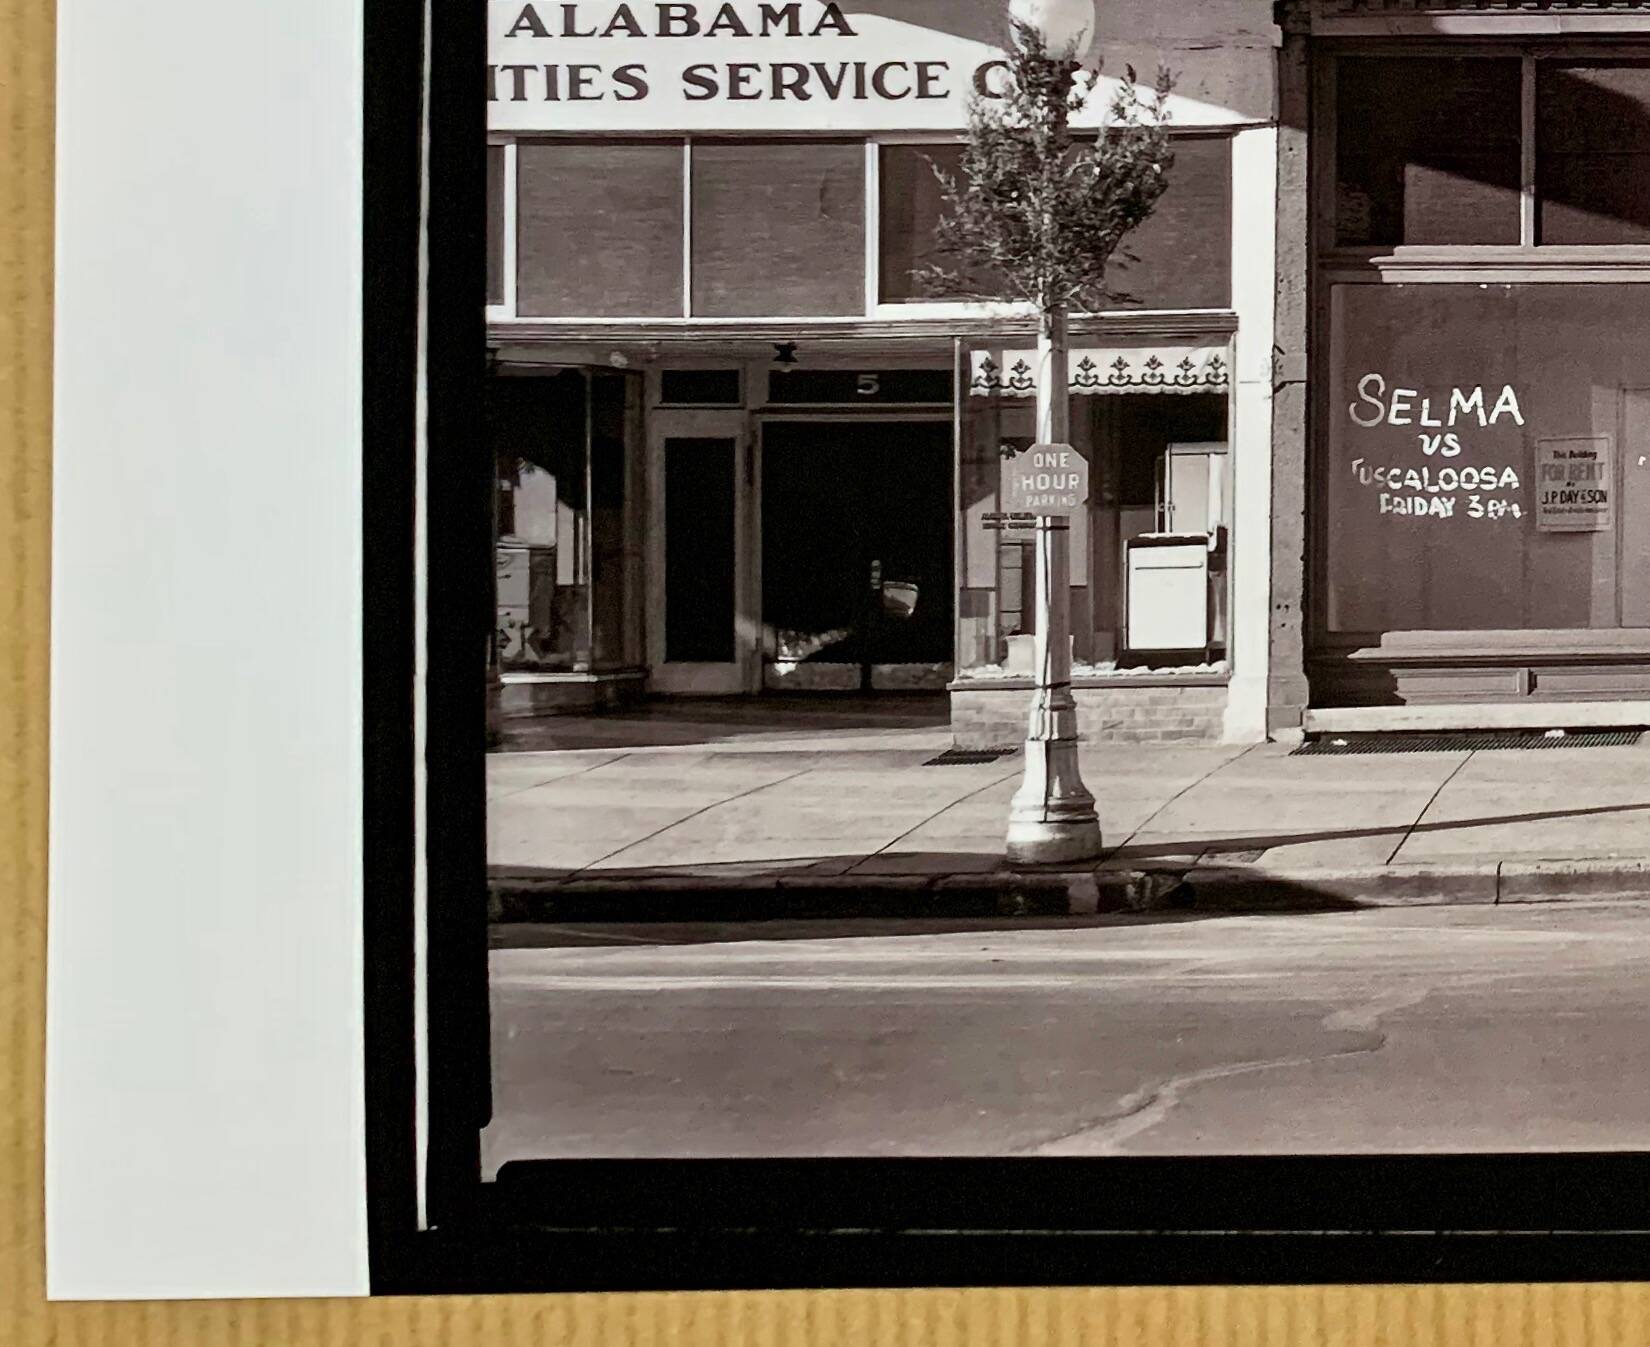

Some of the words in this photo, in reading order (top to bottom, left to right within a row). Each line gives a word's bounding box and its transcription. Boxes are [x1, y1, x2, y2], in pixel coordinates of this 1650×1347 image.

[504, 2, 859, 38] ALABAMA
[487, 63, 649, 102] ITIES
[681, 60, 950, 101] SERVICE
[857, 374, 880, 394] 5
[1350, 373, 1525, 427] SELMA
[1033, 453, 1070, 468] ONE
[1021, 474, 1080, 491] HOUR
[1380, 493, 1456, 518] FRIDAY
[1587, 489, 1608, 504] SON
